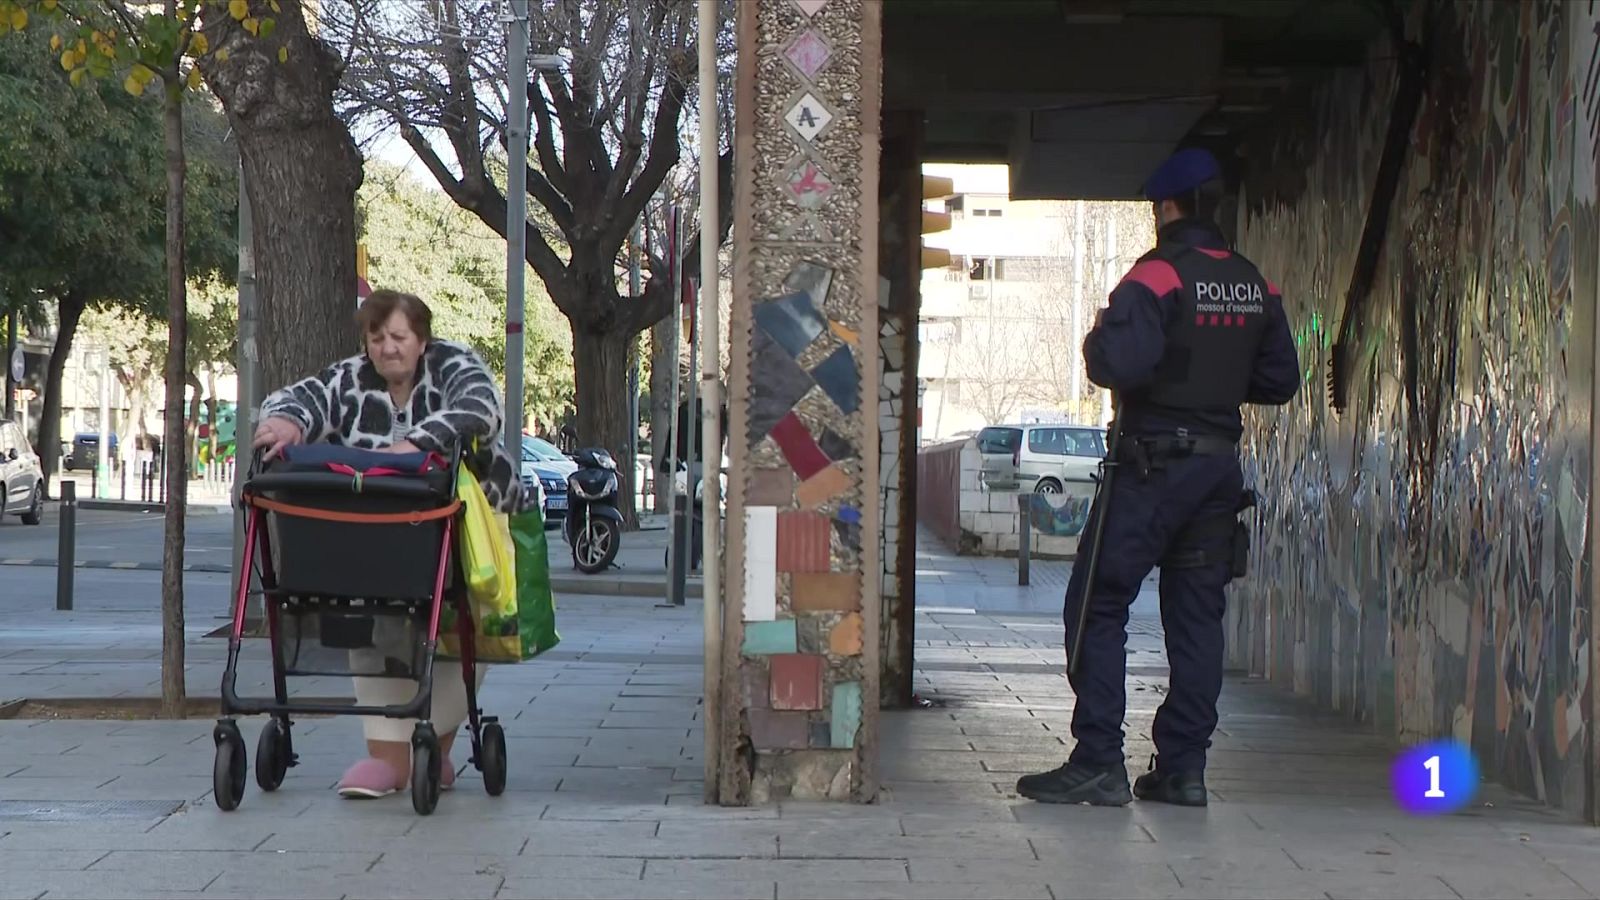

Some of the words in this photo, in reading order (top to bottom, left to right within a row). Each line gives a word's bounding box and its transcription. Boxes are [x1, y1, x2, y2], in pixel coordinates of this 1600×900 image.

[797, 106, 819, 128] A
[1195, 282, 1263, 302] POLICIA
[1196, 304, 1225, 313] mossos
[1226, 303, 1263, 314] d'esquadra
